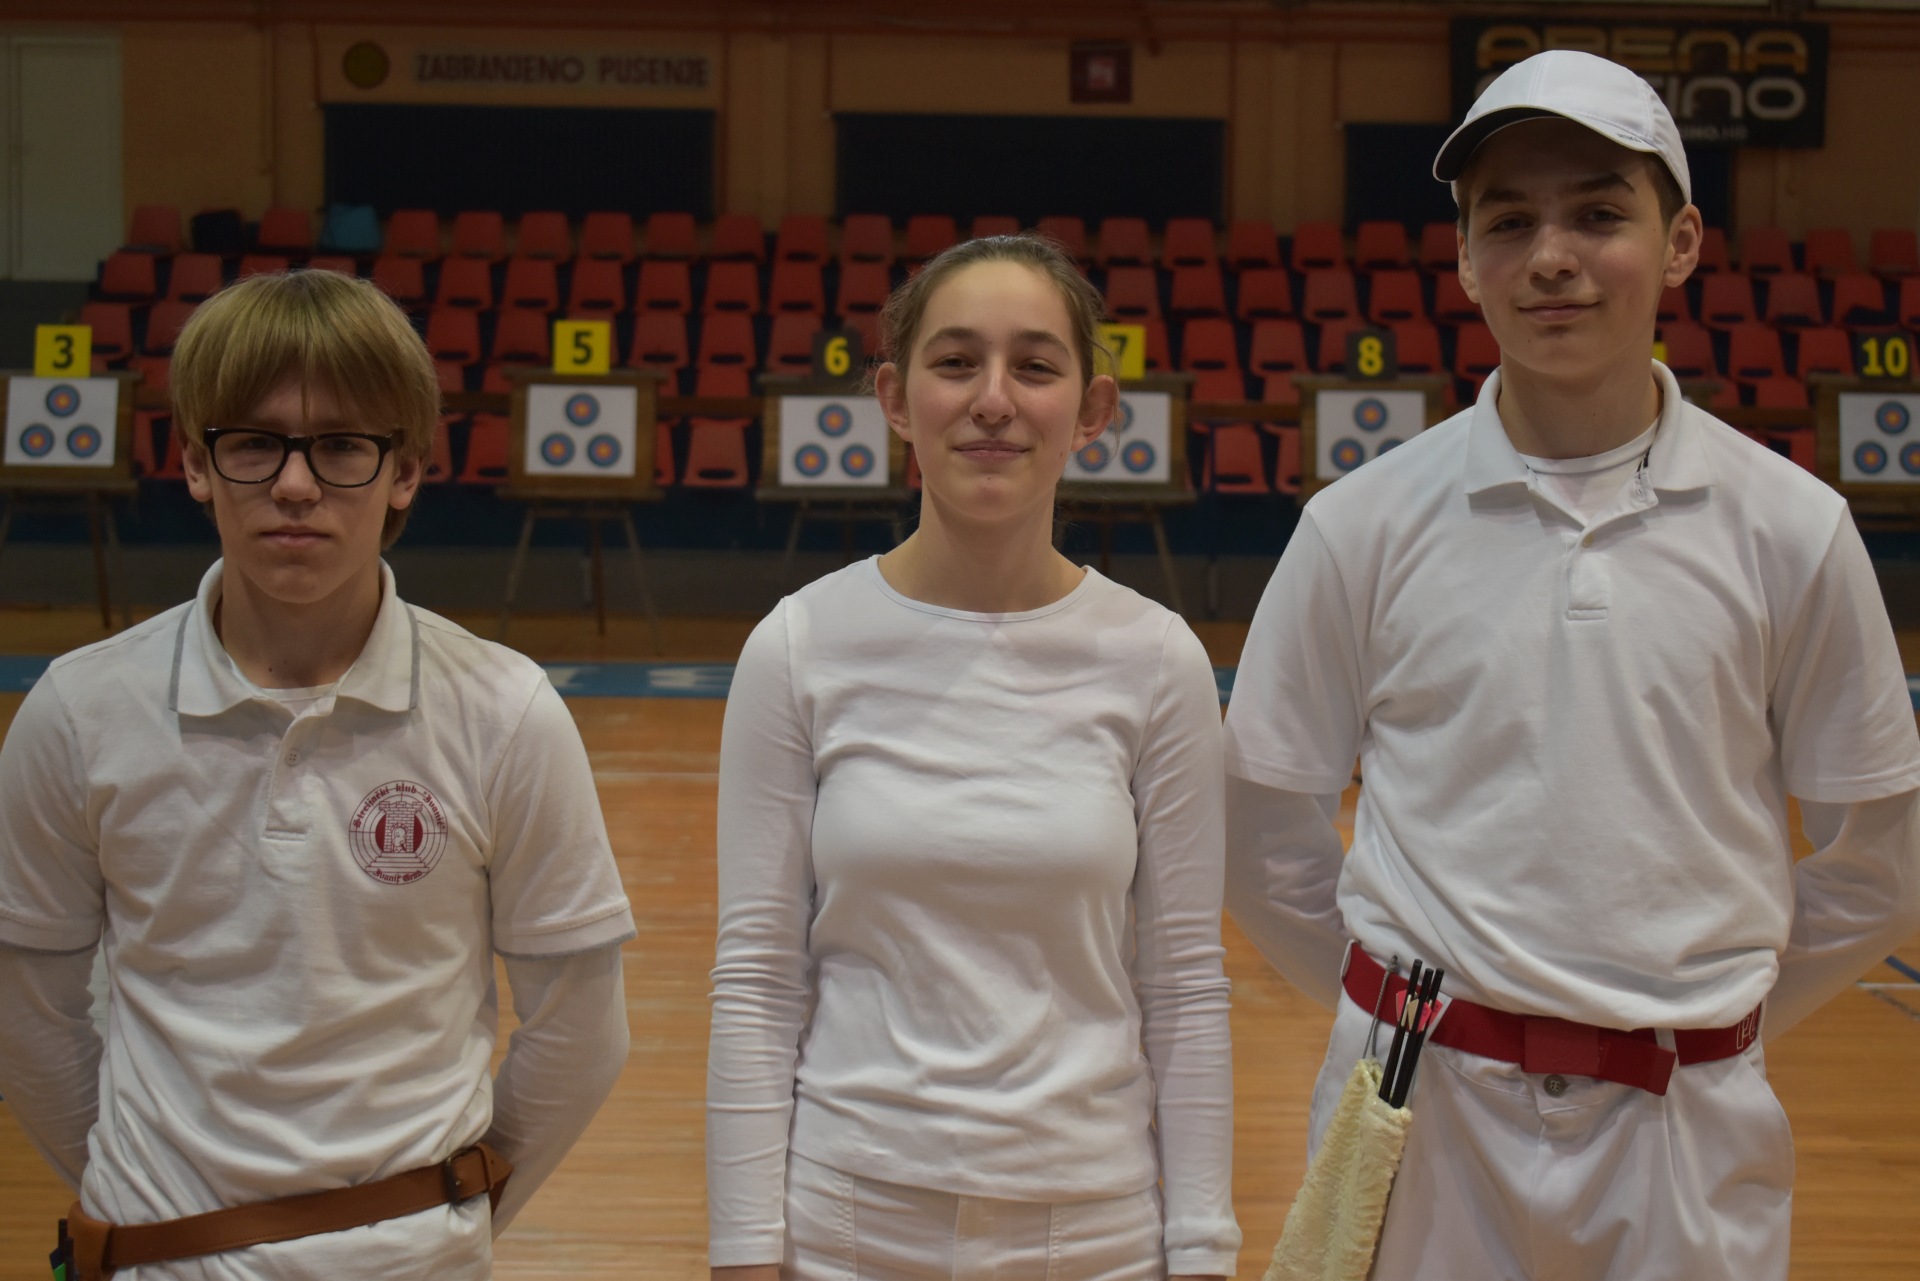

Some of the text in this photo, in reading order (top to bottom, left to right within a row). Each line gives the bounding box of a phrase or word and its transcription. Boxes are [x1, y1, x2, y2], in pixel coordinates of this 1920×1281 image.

[416, 54, 585, 83] ZABRANJENO
[52, 333, 74, 371] 3
[572, 329, 593, 366] 5
[824, 336, 850, 376] 6
[1108, 333, 1128, 366] 7
[1358, 336, 1384, 377] 8
[1862, 337, 1908, 377] 10
[395, 783, 417, 794] klub
